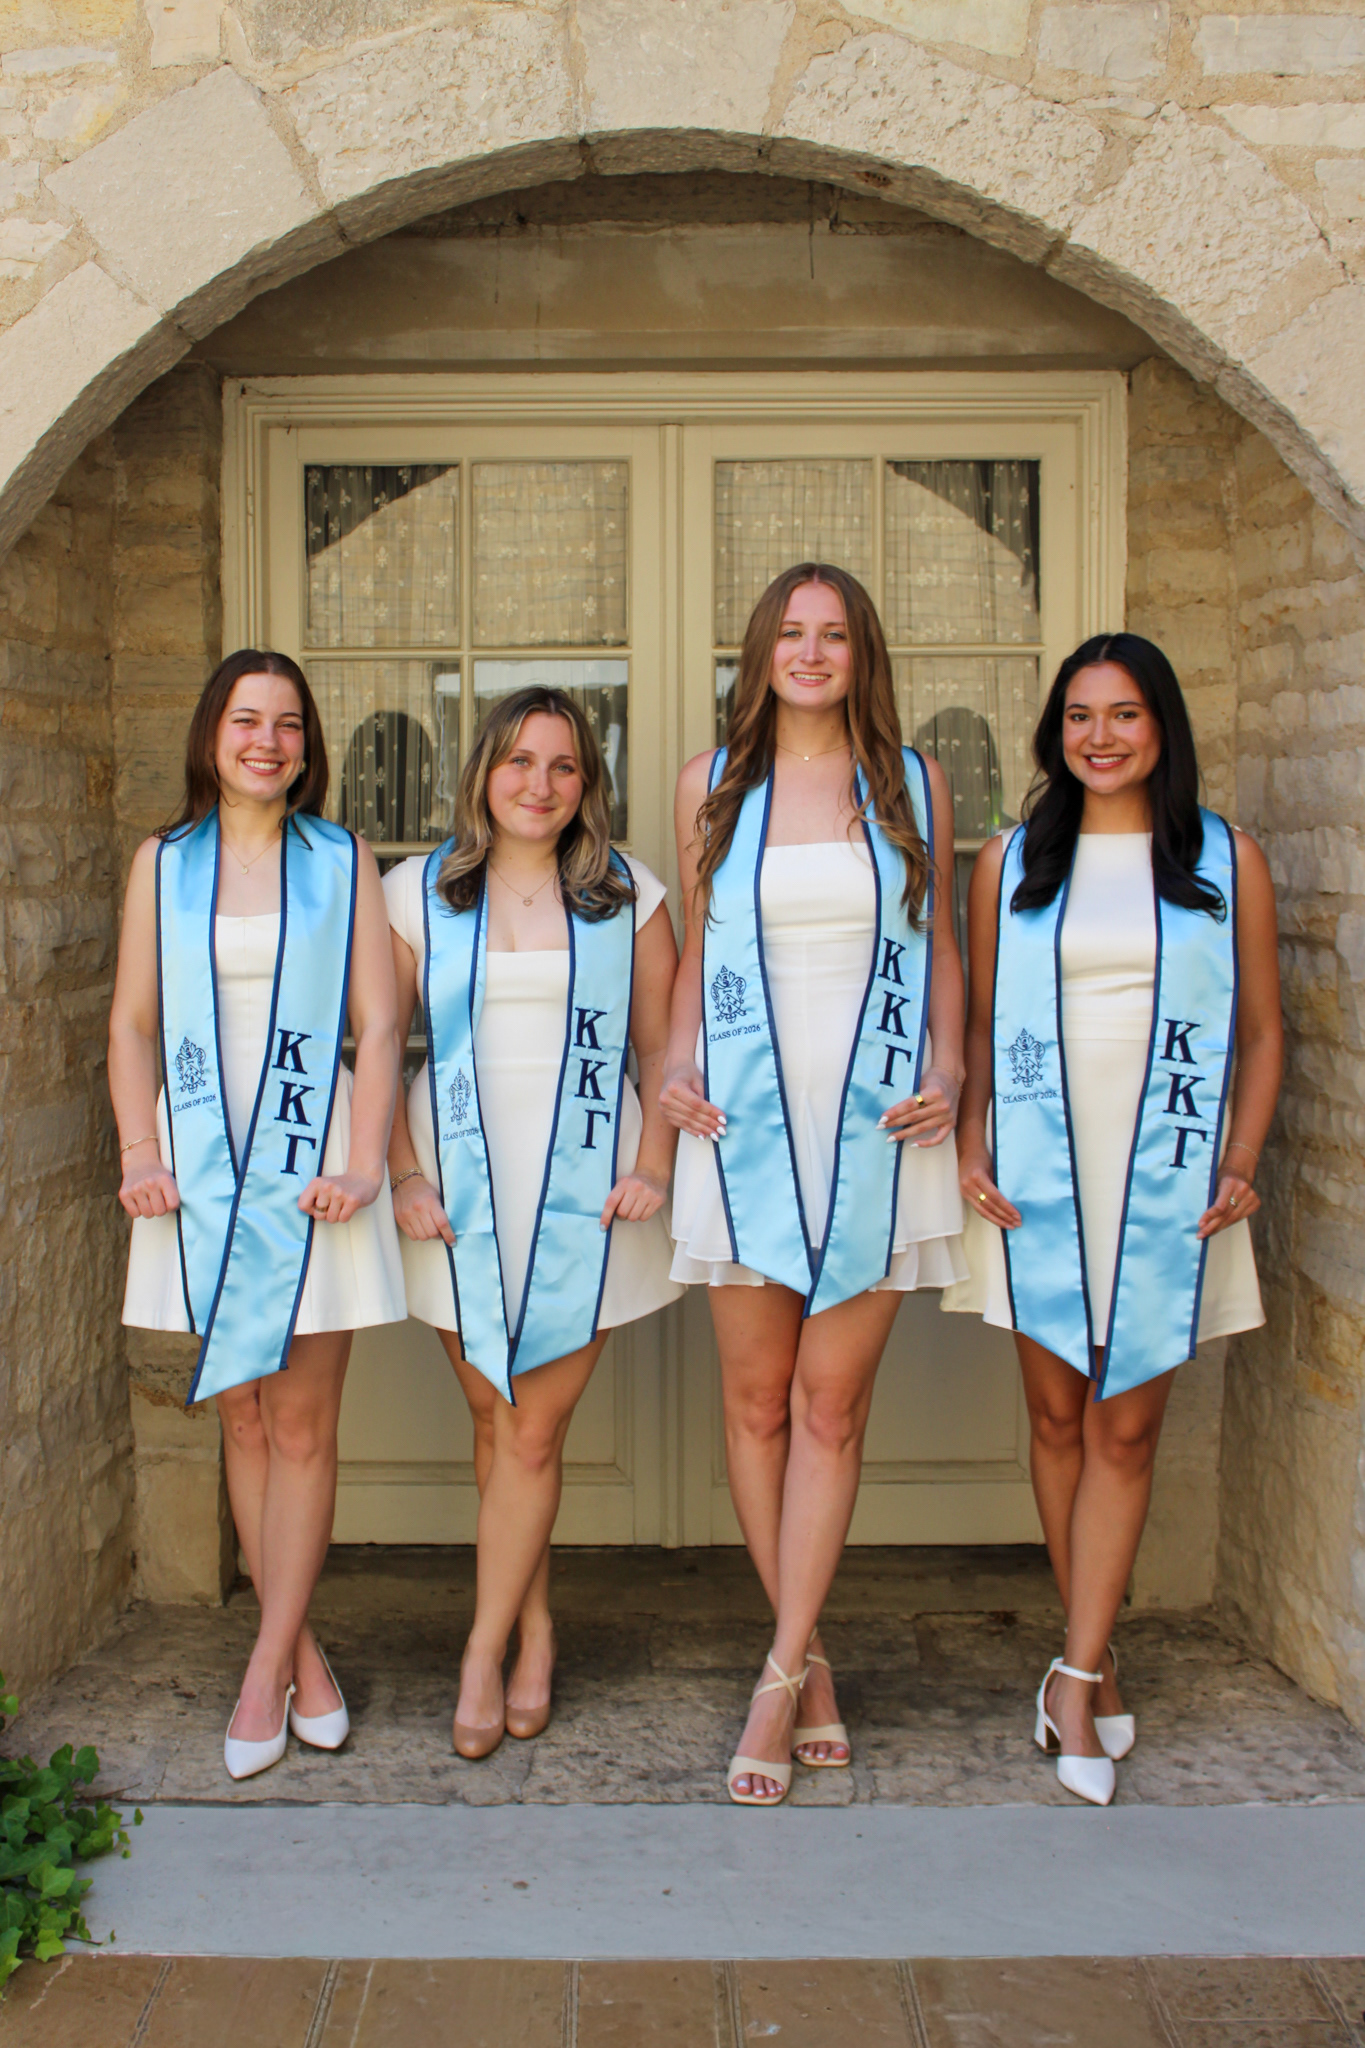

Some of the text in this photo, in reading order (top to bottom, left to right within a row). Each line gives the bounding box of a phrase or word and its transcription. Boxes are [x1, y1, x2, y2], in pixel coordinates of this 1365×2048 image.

[710, 1024, 760, 1041] CLASS OF 2026
[174, 1101, 191, 1112] CLASS
[203, 1094, 216, 1103] 2026
[1003, 1094, 1027, 1103] CLASS
[1041, 1090, 1057, 1099] 2026
[443, 1131, 458, 1141] CLASS
